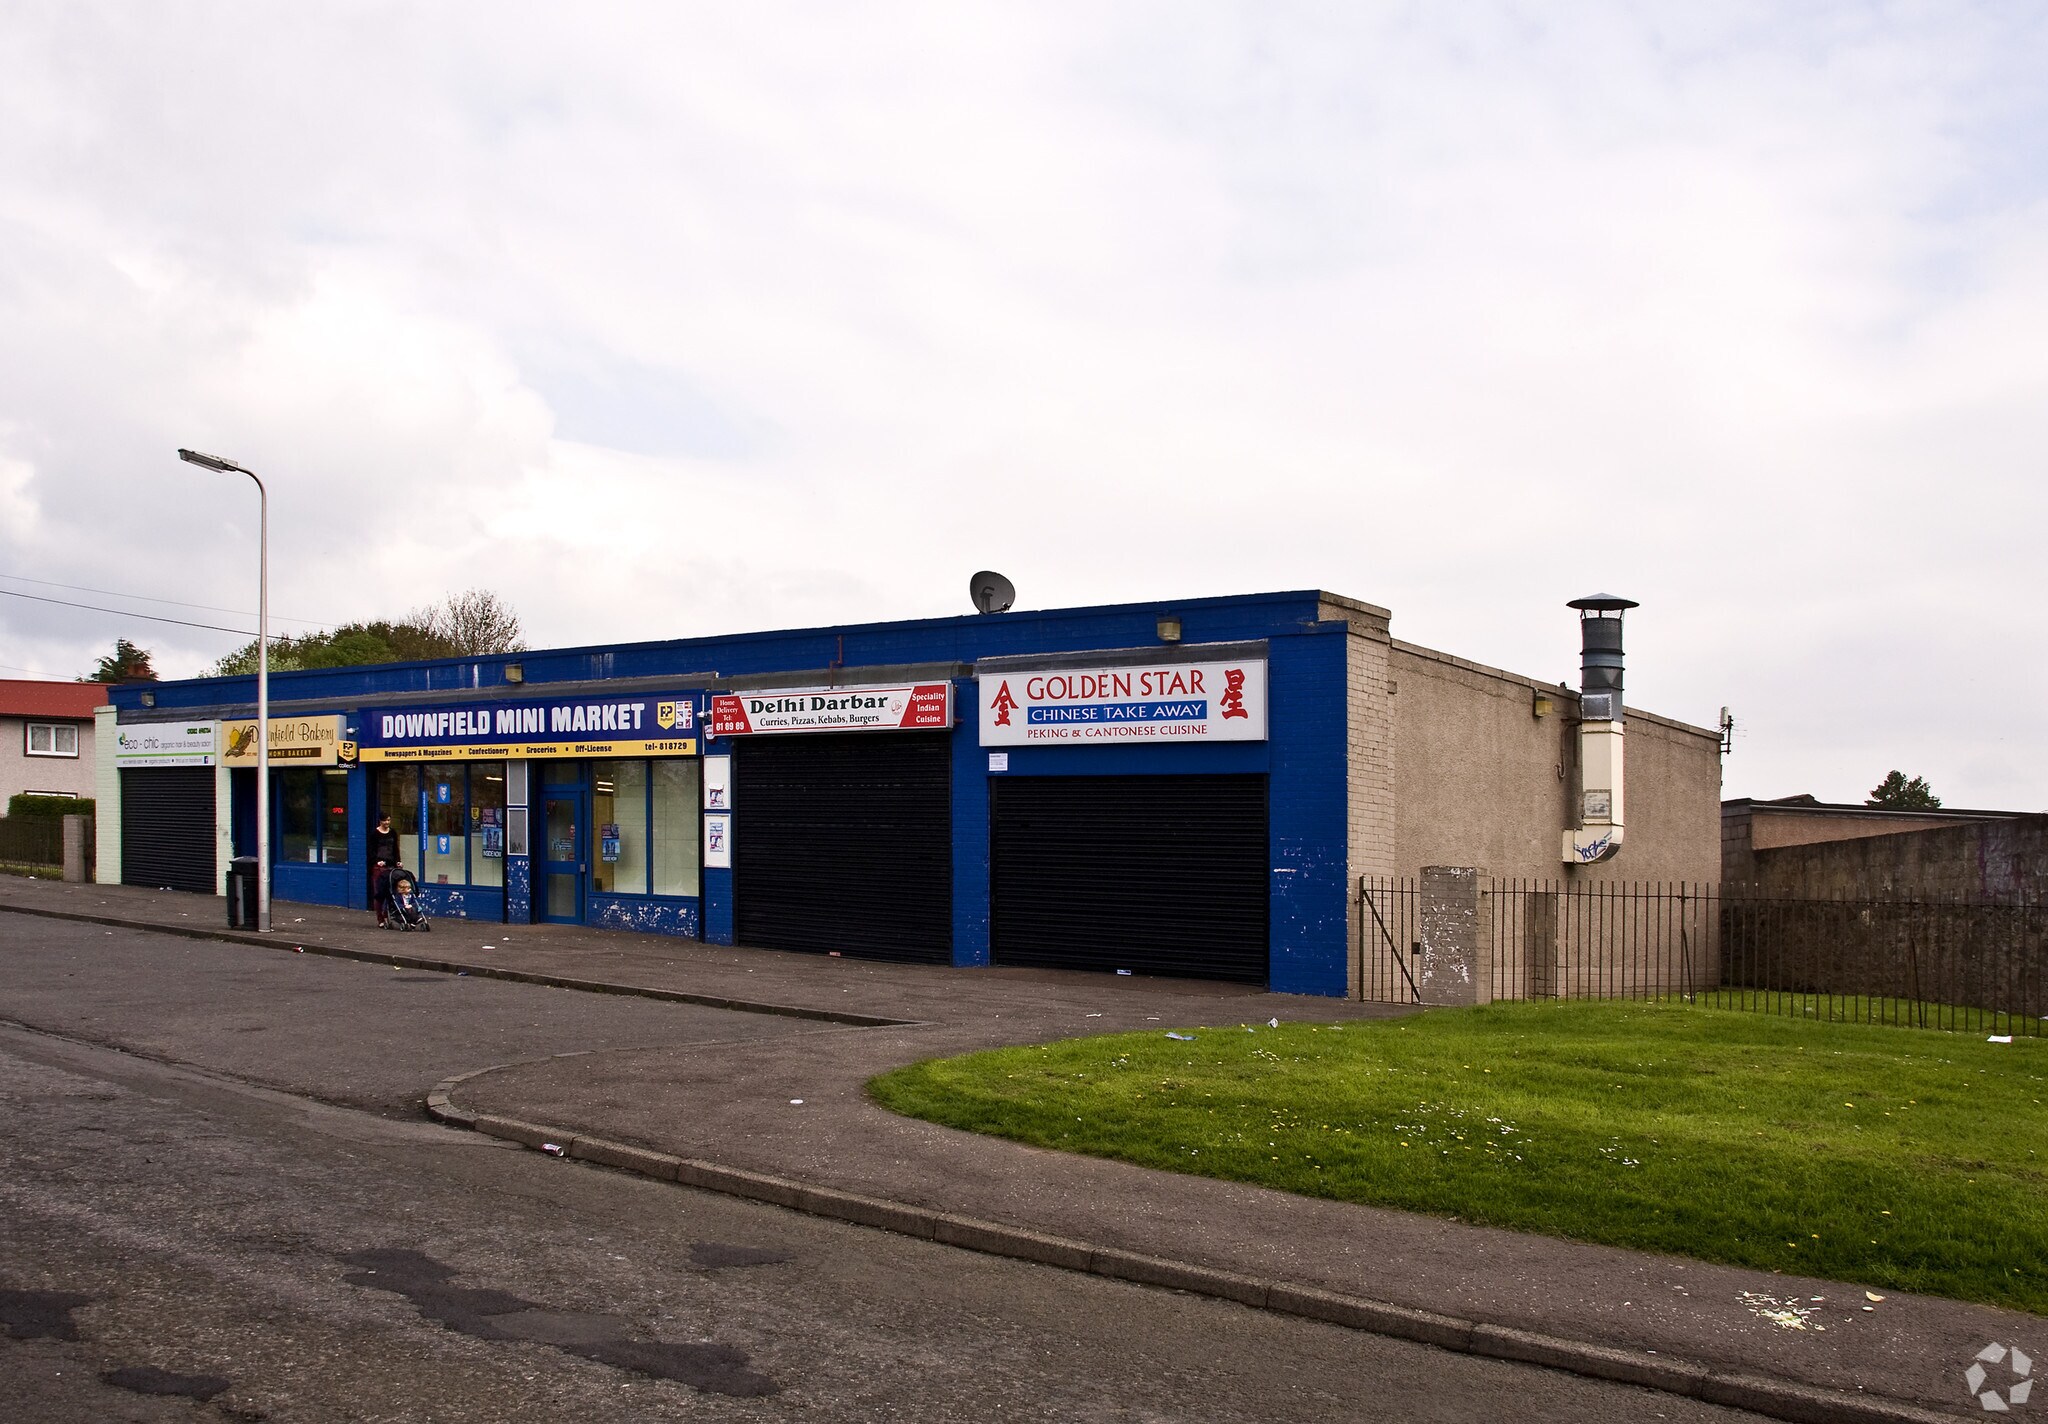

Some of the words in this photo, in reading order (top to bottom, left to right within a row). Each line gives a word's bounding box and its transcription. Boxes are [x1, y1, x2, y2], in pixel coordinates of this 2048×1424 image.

[1026, 673, 1131, 700] GOLDEN
[1141, 669, 1207, 696] STAR
[912, 693, 945, 702] Speciality
[1220, 668, 1249, 720] 星
[750, 698, 805, 714] Delhi
[811, 695, 888, 711] Darbar
[917, 704, 940, 712] Indian
[990, 679, 1019, 727] 金
[916, 715, 941, 723] Cuisine
[1031, 707, 1098, 721] CHINESE
[1103, 705, 1147, 719] TAKE
[1152, 703, 1203, 718] AWAY
[382, 710, 490, 738] DOWNFIELD
[496, 707, 545, 734] MINI
[551, 703, 645, 732] MARKET
[716, 722, 723, 731] 81
[725, 722, 734, 731] 89
[735, 721, 744, 730] 89
[760, 717, 790, 726] Curries,
[791, 716, 817, 725] Pizzas,
[818, 714, 848, 724] Kebabs,
[849, 714, 880, 725] Burgers
[298, 722, 334, 746] Bakery
[1027, 728, 1068, 738] PEKING
[1071, 729, 1081, 738] &
[1085, 726, 1156, 737] CANTONESE
[1159, 724, 1208, 735] CUISINE
[124, 739, 138, 749] eco
[144, 737, 159, 749] chic
[659, 742, 687, 750] 818729
[384, 750, 417, 758] Newspapers
[423, 748, 452, 757] Magazines
[468, 747, 509, 755] Confectionery
[526, 745, 557, 753] Groceries
[575, 744, 612, 752] Off-License
